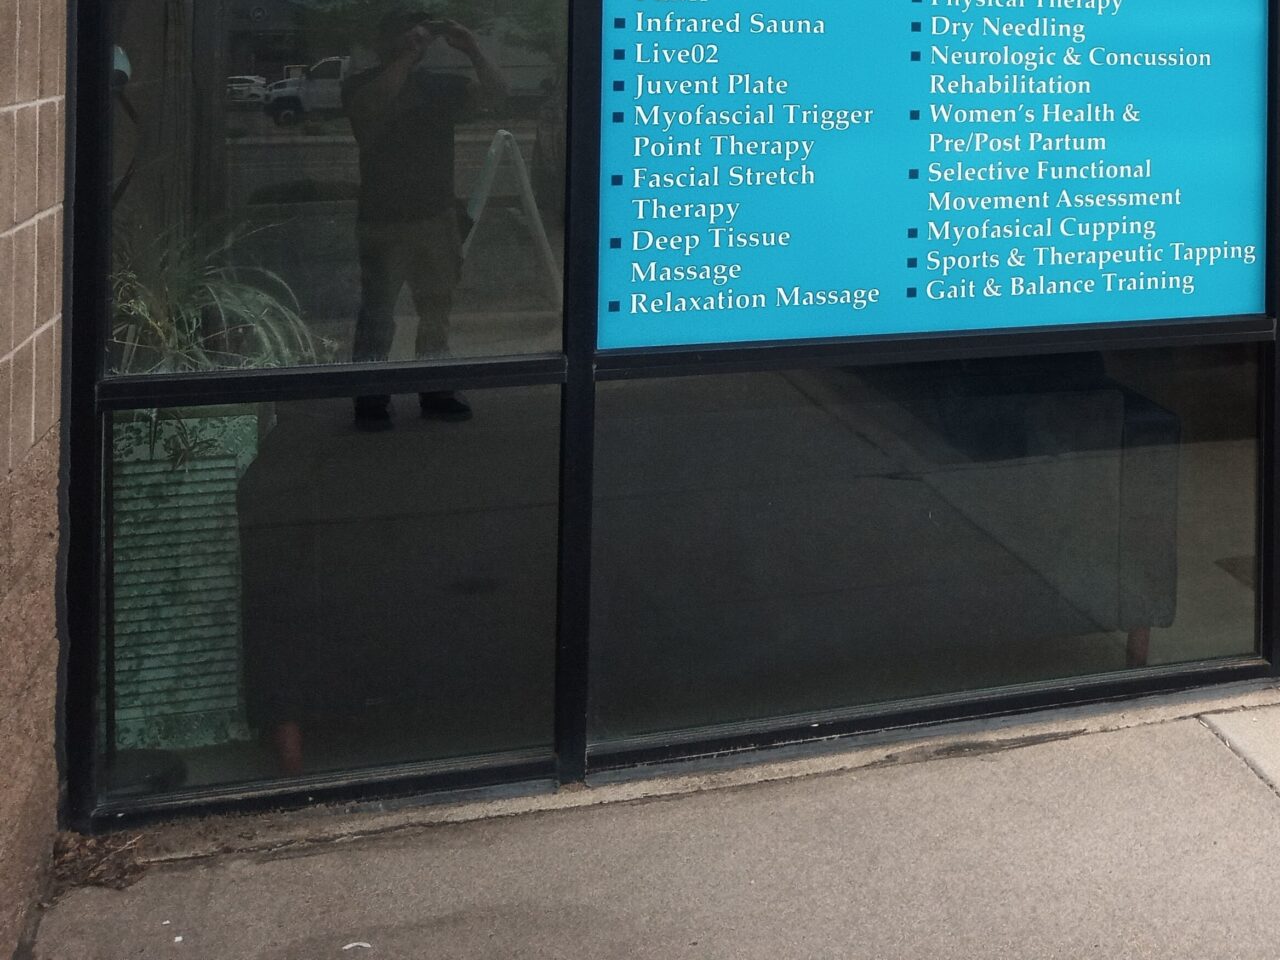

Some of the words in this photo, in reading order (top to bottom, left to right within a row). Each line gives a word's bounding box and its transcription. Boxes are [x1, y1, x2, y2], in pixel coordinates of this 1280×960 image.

[635, 12, 741, 33] Infrared
[750, 13, 825, 34] Sauna
[931, 16, 974, 42] Dry
[982, 17, 1085, 43] Needling
[930, 46, 1056, 71] Neurologic
[1063, 47, 1081, 66] &
[1089, 47, 1212, 67] Concussion
[634, 74, 719, 100] Juvent
[728, 74, 788, 94] Plate
[930, 74, 1091, 94] Rehabilitation
[634, 105, 774, 132] Myofascial
[783, 104, 874, 130] Trigger
[1042, 104, 1115, 123] Health
[1122, 104, 1141, 122] &
[633, 136, 702, 157] Point
[710, 135, 815, 161] Therapy
[929, 132, 1021, 152] Pre/Post
[1029, 132, 1106, 151] Partum
[633, 167, 719, 188] Fascial
[728, 165, 816, 187] Stretch
[928, 161, 1029, 182] Selective
[1037, 160, 1152, 180] Functional
[632, 199, 740, 223] Therapy
[928, 191, 1049, 211] Movement
[1056, 188, 1182, 208] Assessment
[632, 231, 700, 255] Deep
[708, 228, 791, 248] Tissue
[927, 218, 1052, 246] Myofasical
[1059, 217, 1157, 240] Cupping
[927, 249, 1000, 275] Sports
[1007, 249, 1026, 267] &
[1034, 244, 1163, 269] Therapeutic
[1170, 241, 1256, 265] Tapping
[631, 262, 742, 286] Massage
[926, 278, 976, 299] Gait
[983, 278, 1002, 297] &
[1010, 275, 1095, 296] Balance
[1102, 271, 1195, 294] Training
[630, 290, 767, 314] Relaxation
[775, 286, 880, 309] Massage
